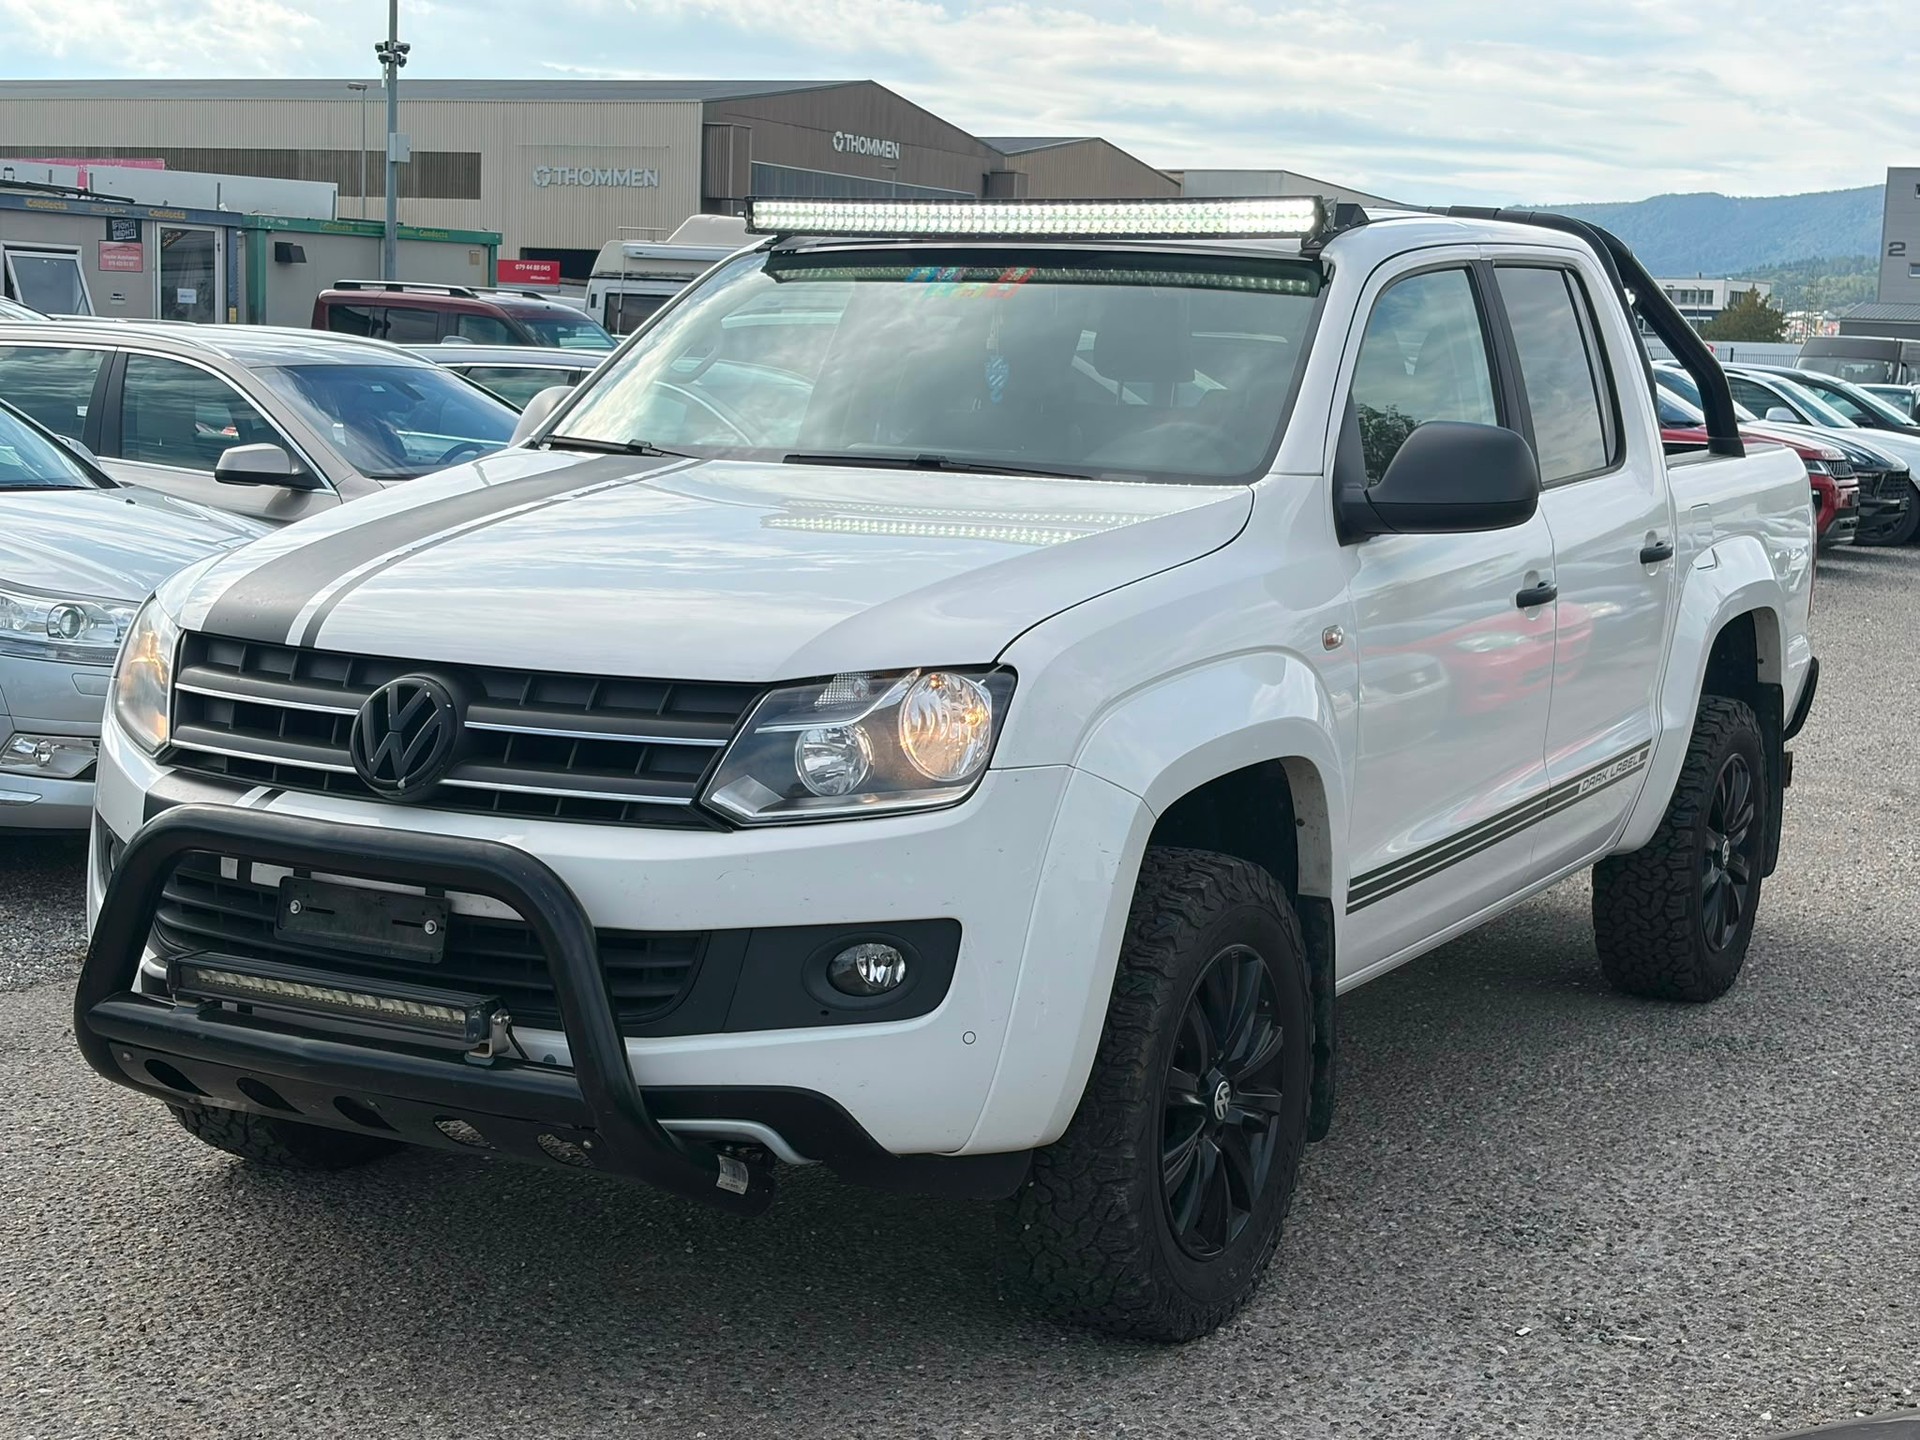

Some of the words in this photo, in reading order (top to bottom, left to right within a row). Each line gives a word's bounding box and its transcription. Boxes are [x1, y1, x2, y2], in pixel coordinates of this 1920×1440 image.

[844, 133, 900, 160] THOMMEN
[554, 167, 659, 188] THOMMEN
[1887, 241, 1906, 257] 2
[515, 263, 526, 271] 079
[1582, 768, 1609, 792] DARK
[1610, 754, 1639, 778] LABEL
